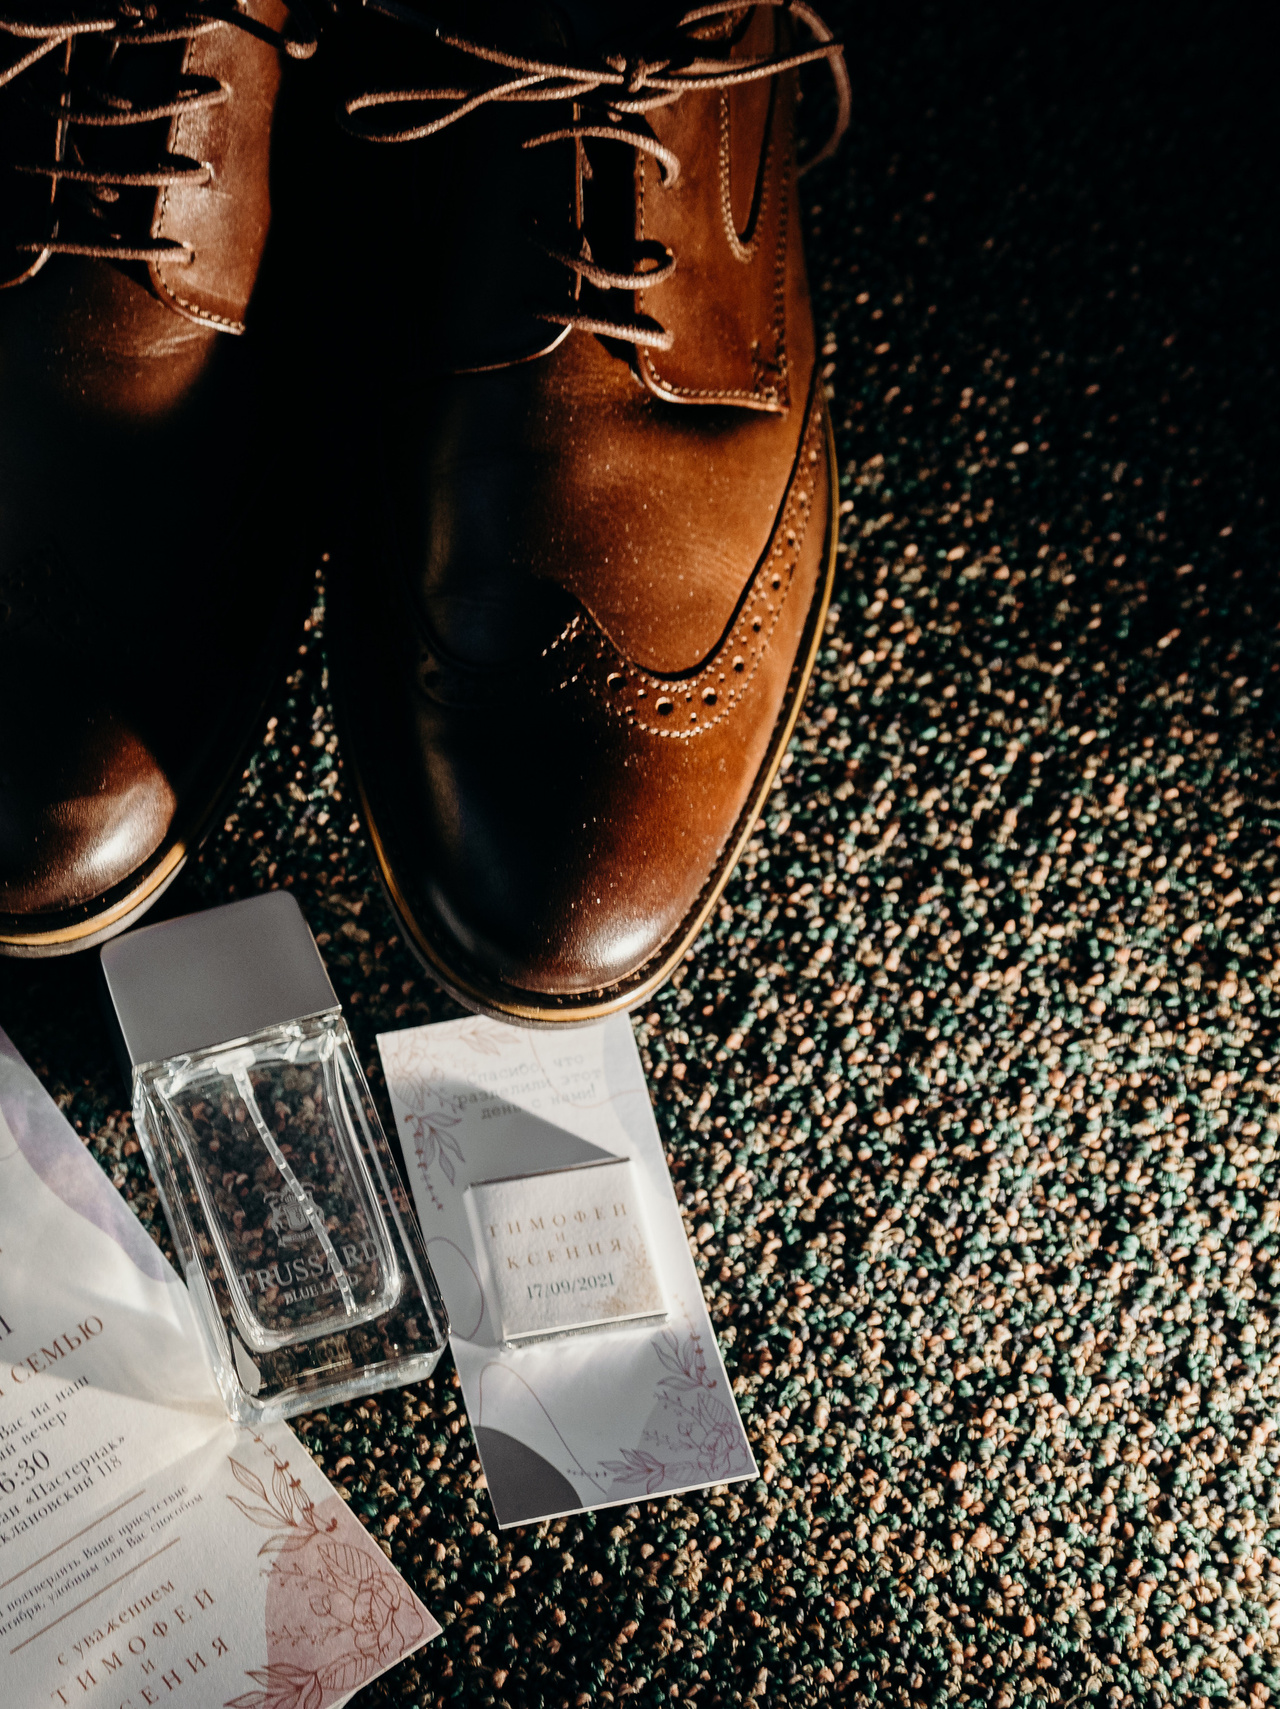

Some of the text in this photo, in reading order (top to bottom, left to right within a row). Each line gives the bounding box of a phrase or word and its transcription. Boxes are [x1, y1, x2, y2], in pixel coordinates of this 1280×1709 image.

[553, 1054, 584, 1068] что
[561, 1068, 602, 1085] этот
[482, 1103, 522, 1120] день
[531, 1099, 542, 1109] с
[506, 1238, 622, 1270] КСЕНИЯ
[284, 1274, 359, 1306] BLUE LAD
[527, 1272, 616, 1300] 17/09/2021
[10, 1315, 104, 1385] СЕМЬЮ
[30, 1401, 52, 1419] на
[55, 1374, 90, 1403] наш
[21, 1410, 68, 1446] вечер
[25, 1435, 126, 1505] «Пастернак»
[97, 1454, 123, 1478] 118
[6, 1555, 82, 1613] подтвердить
[82, 1534, 116, 1560] Ваше
[118, 1484, 189, 1538] присутствие
[47, 1565, 100, 1605] удобным
[125, 1532, 147, 1549] Вас
[149, 1493, 204, 1534] способом
[57, 1579, 176, 1666] с уважением
[50, 1587, 216, 1706] ТИМОФЕЙ
